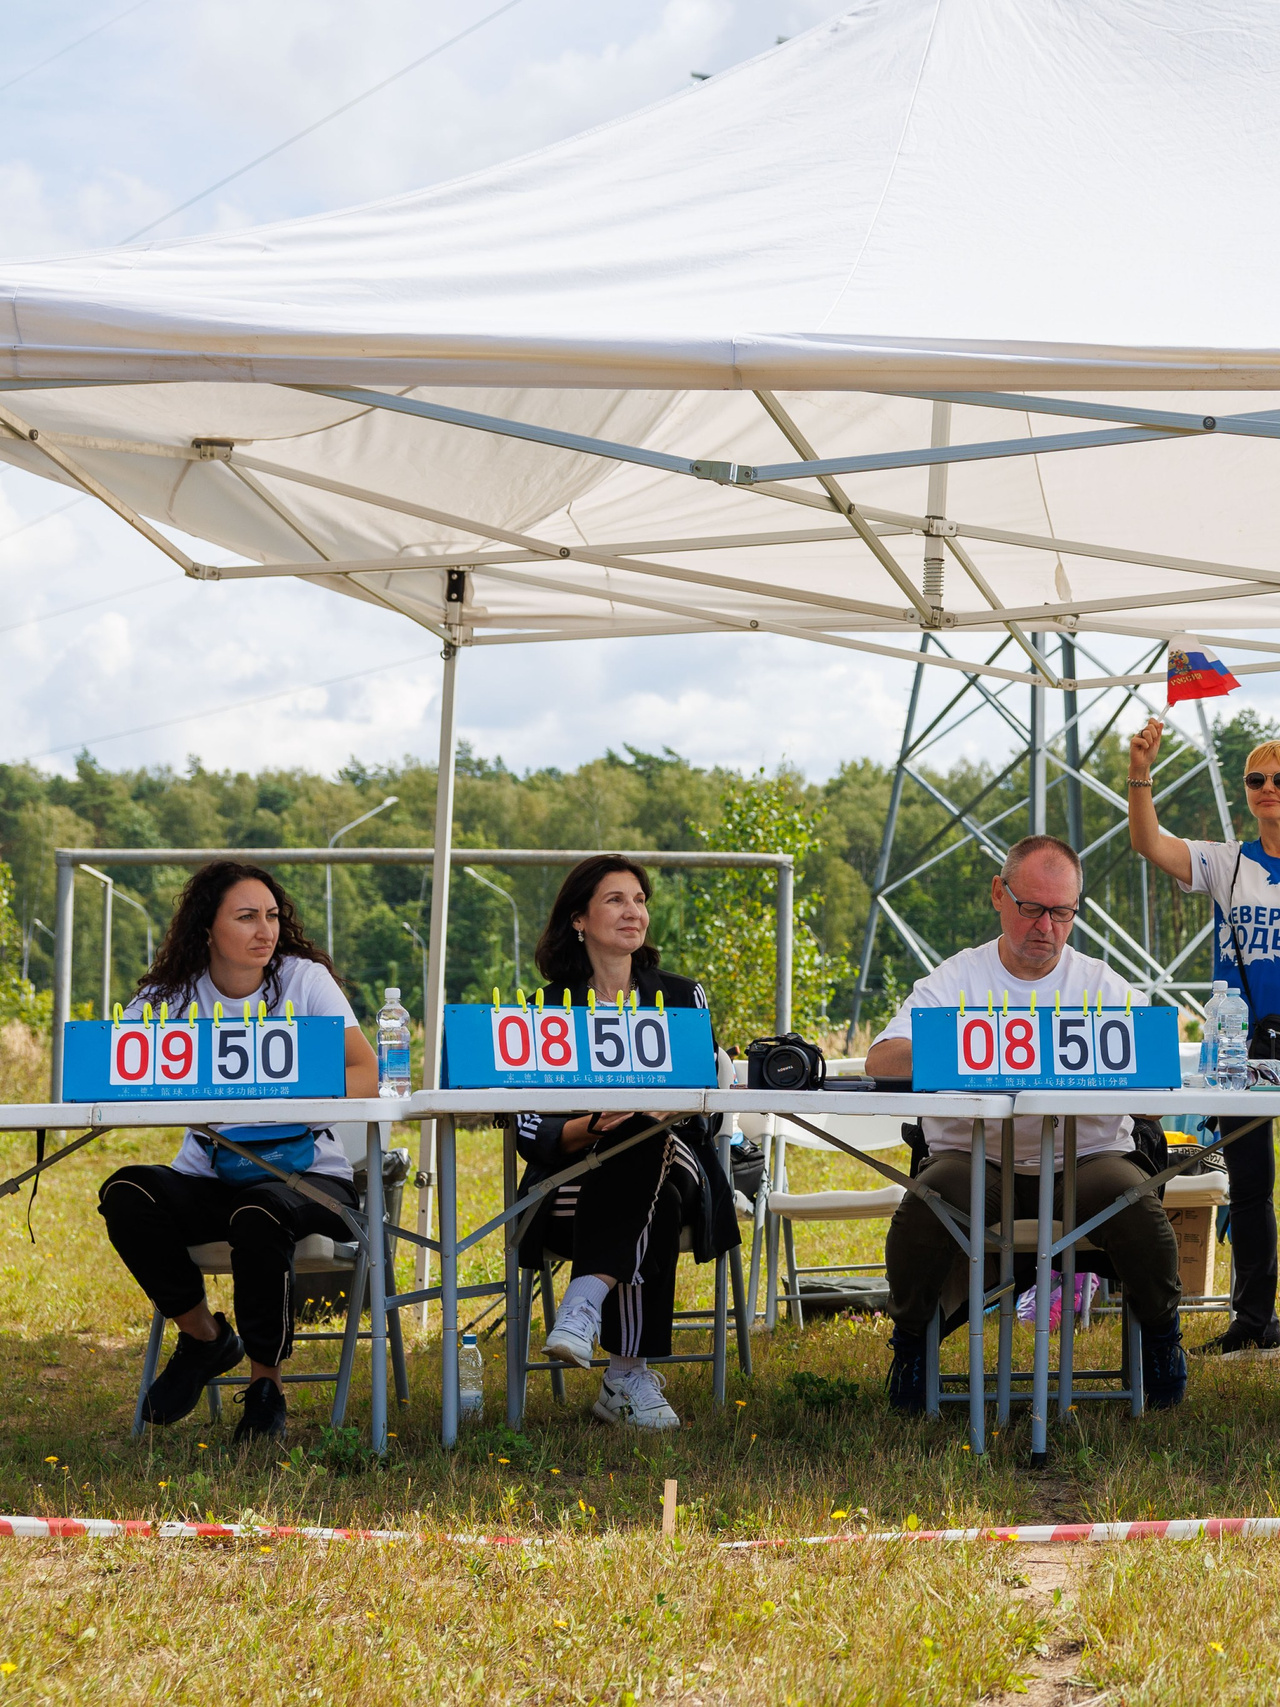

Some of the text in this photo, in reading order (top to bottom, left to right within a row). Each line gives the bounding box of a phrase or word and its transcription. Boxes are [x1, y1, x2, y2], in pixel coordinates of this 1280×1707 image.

[117, 1028, 294, 1081] 09 50
[498, 1015, 665, 1067] 08 50
[963, 1018, 1131, 1071] 08 50
